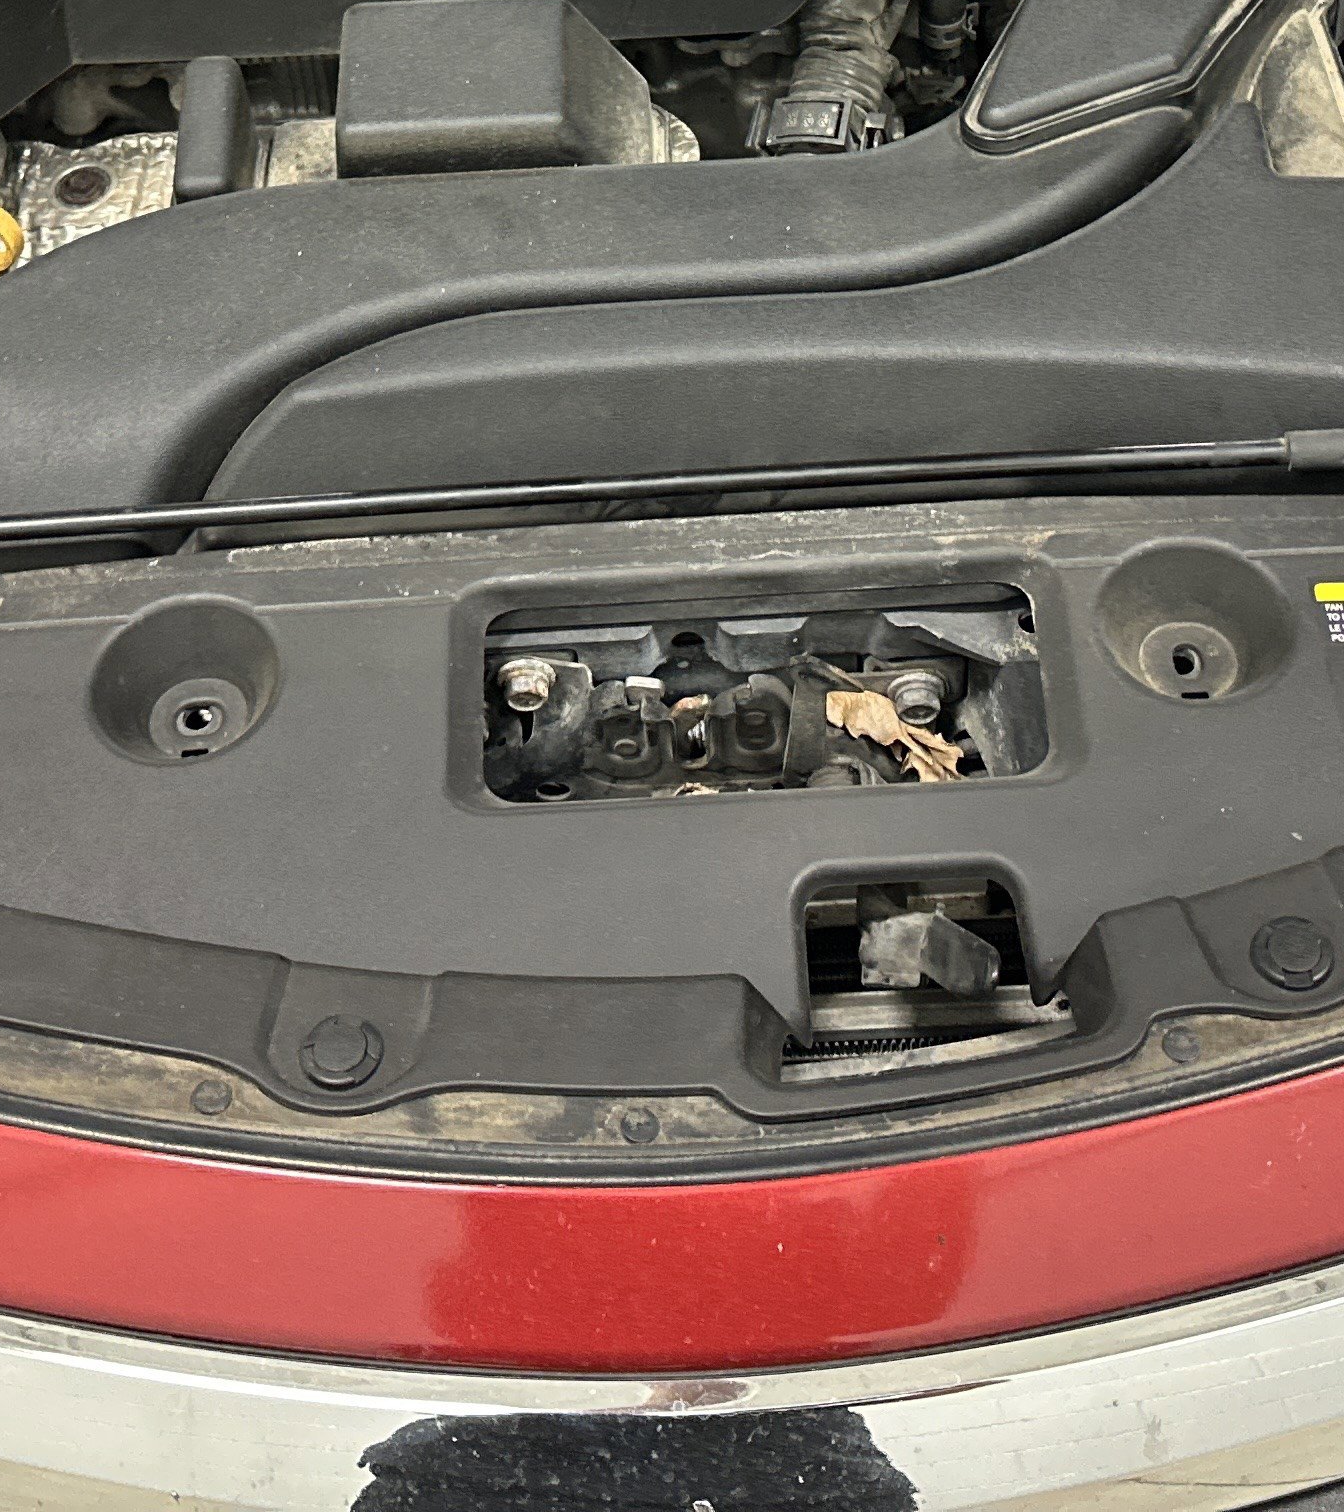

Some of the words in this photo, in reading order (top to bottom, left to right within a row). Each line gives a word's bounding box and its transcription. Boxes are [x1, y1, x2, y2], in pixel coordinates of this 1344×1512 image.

[1324, 603, 1343, 612] FAN
[1326, 612, 1341, 621] TO
[1328, 623, 1342, 632] LE
